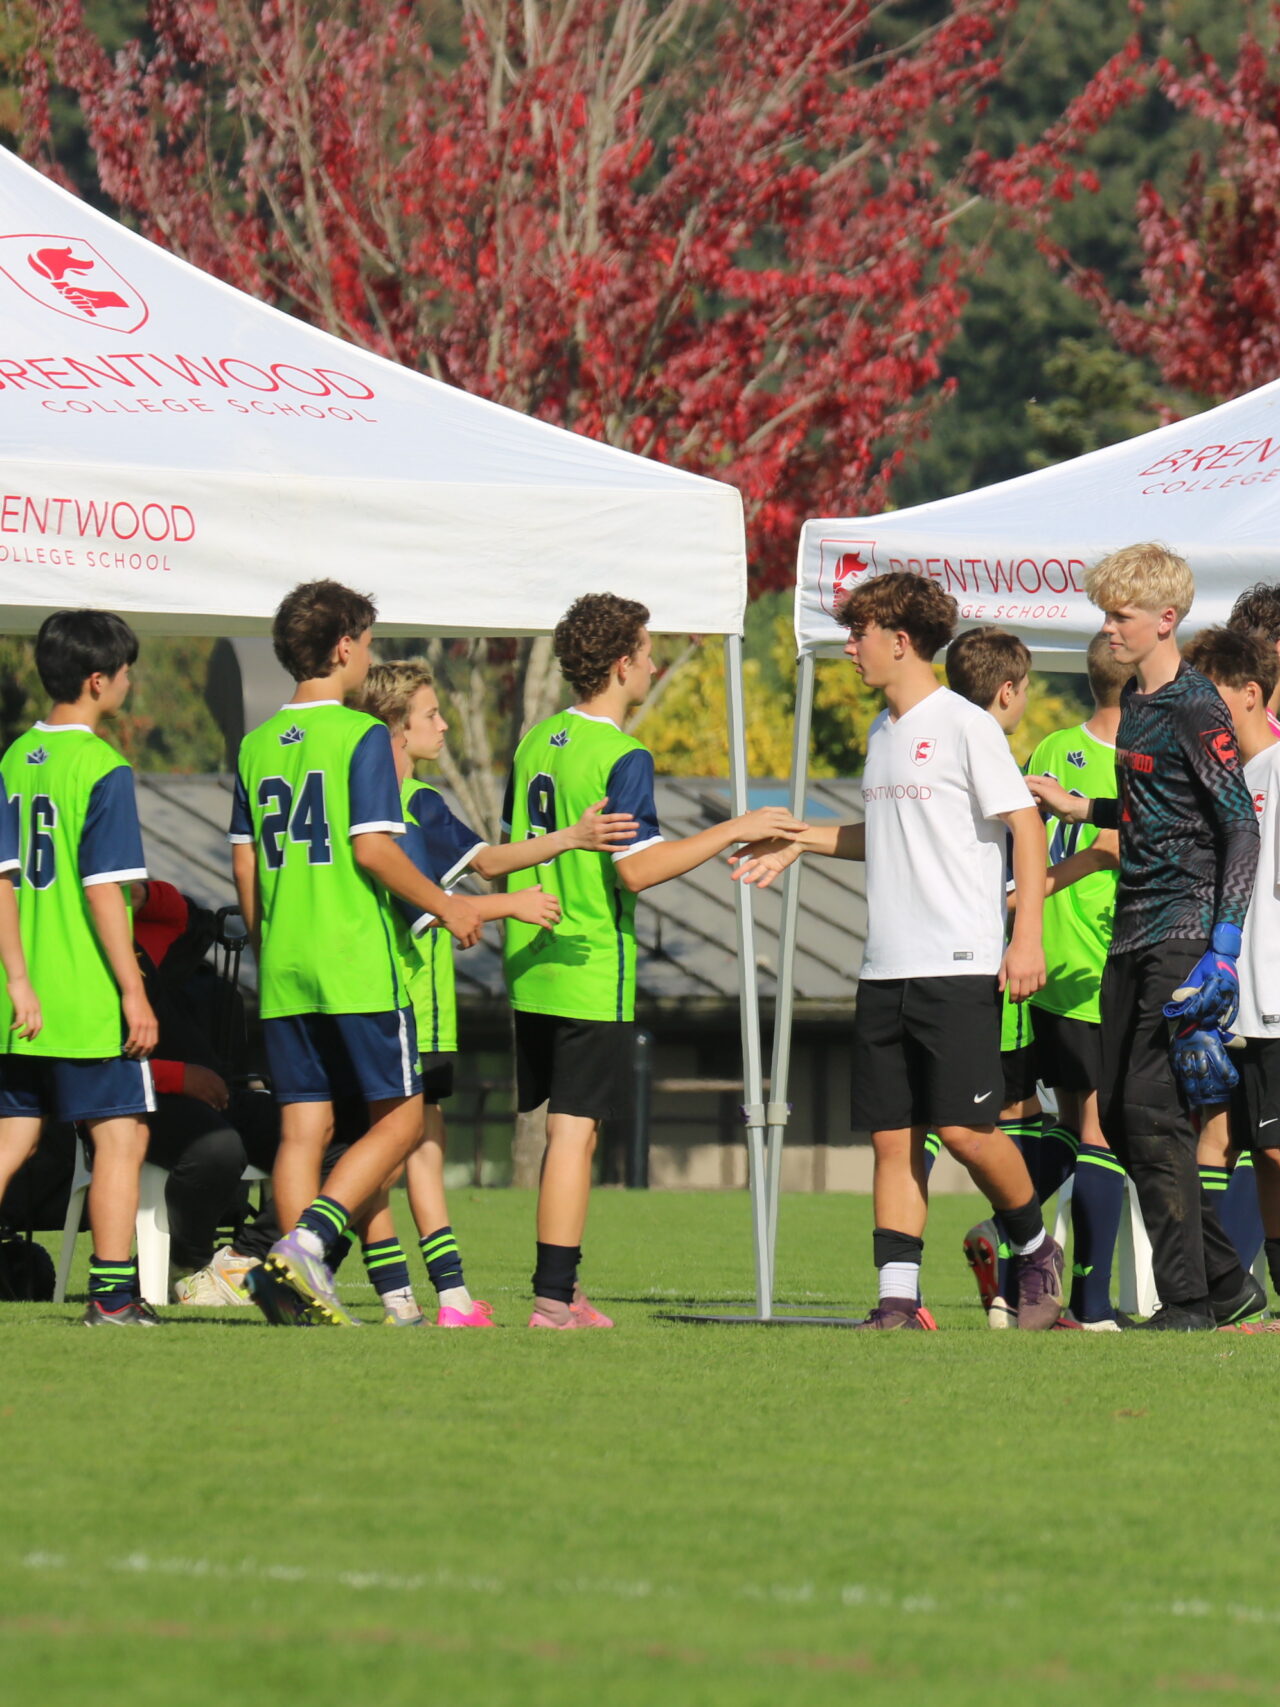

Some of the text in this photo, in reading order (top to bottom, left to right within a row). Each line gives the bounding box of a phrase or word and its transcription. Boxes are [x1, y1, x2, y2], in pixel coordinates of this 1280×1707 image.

[0, 353, 376, 400] RENTWOOD
[41, 397, 378, 423] COLLEGE SCHOOL
[86, 550, 171, 572] SCHOOL
[994, 604, 1068, 619] SCHOOL
[257, 770, 333, 871] 24
[525, 771, 558, 867] 9
